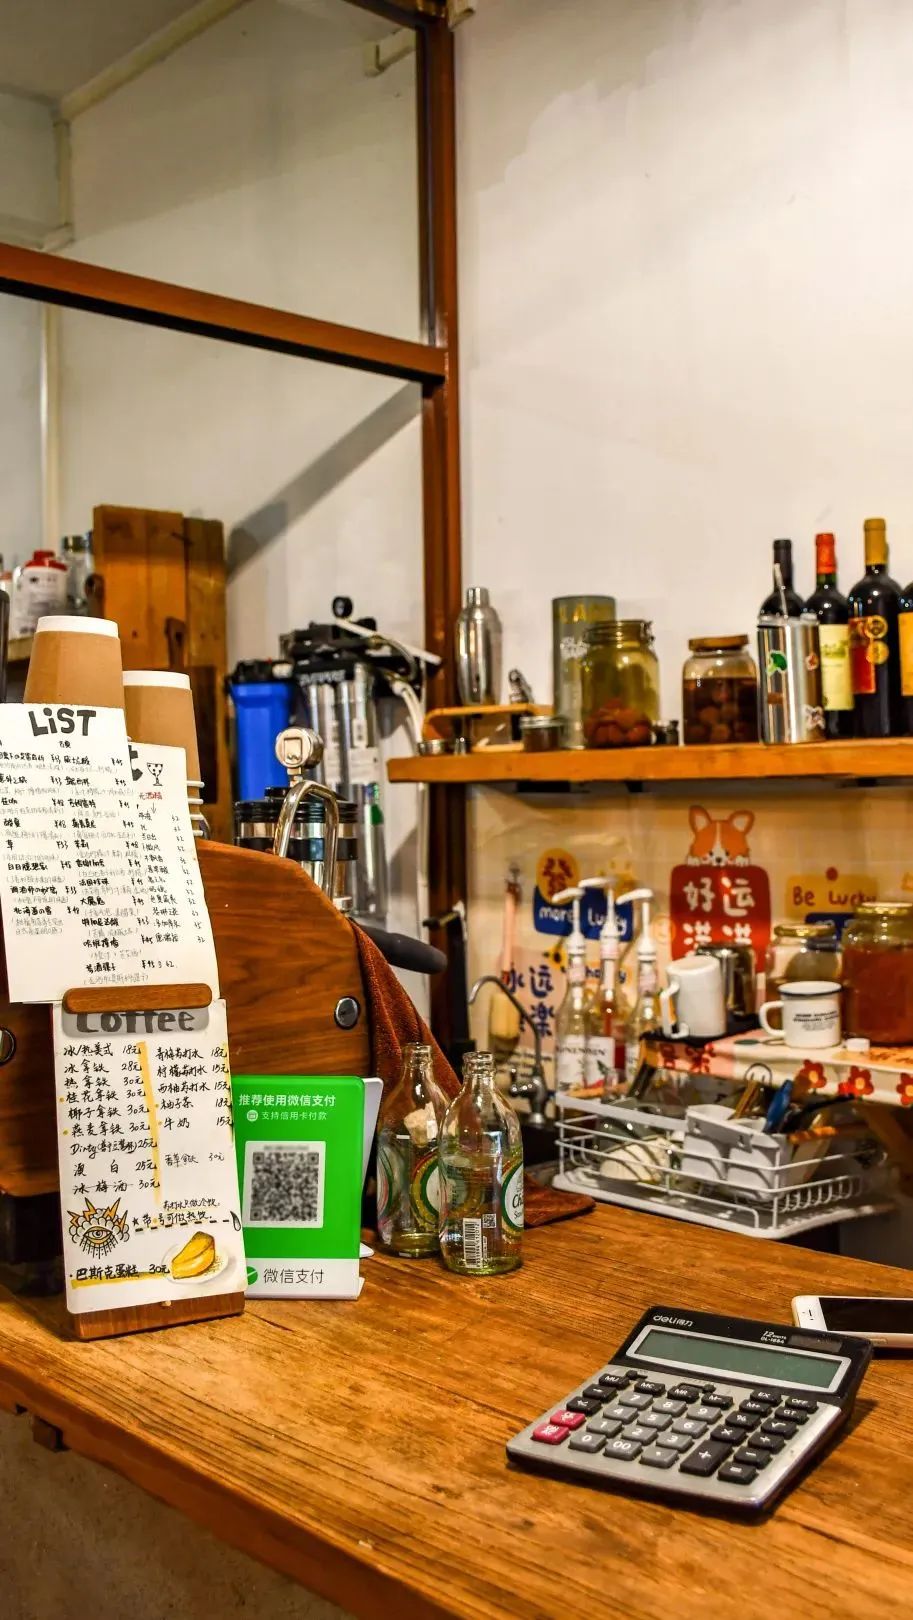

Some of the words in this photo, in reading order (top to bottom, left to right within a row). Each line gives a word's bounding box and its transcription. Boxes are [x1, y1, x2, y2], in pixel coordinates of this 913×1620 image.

[28, 707, 96, 736] LiST
[682, 877, 755, 917] 好运
[793, 886, 815, 906] Be
[122, 1044, 141, 1054] 18元
[211, 1047, 227, 1057] 18元
[64, 1058, 109, 1073] 冰拿铁
[121, 1060, 142, 1072] 28元
[212, 1063, 229, 1073] 15元
[64, 1075, 110, 1089] 热拿铁
[123, 1076, 144, 1086] 30元
[214, 1081, 230, 1091] 15元
[66, 1088, 119, 1103] 桂花拿铁
[126, 1089, 146, 1098] 30元
[239, 1094, 336, 1107] 推荐使用微信支付
[215, 1097, 232, 1109] 18元
[68, 1104, 121, 1119] 椰子拿铁
[127, 1105, 149, 1115] 30元
[261, 1111, 327, 1121] 支持信用卡付款
[72, 1121, 124, 1137] 燕麦拿铁
[129, 1122, 150, 1132] 30元
[164, 1117, 190, 1130] 牛奶
[216, 1116, 233, 1127] 15元
[138, 1138, 157, 1148] 25元
[136, 1159, 157, 1171] 25元
[139, 1179, 160, 1189] 30元
[75, 1263, 139, 1280] 巴斯克蛋糕
[149, 1264, 170, 1274] 30元
[263, 1268, 324, 1284] 微信支付
[653, 1315, 676, 1324] deli
[612, 1441, 632, 1450] 00
